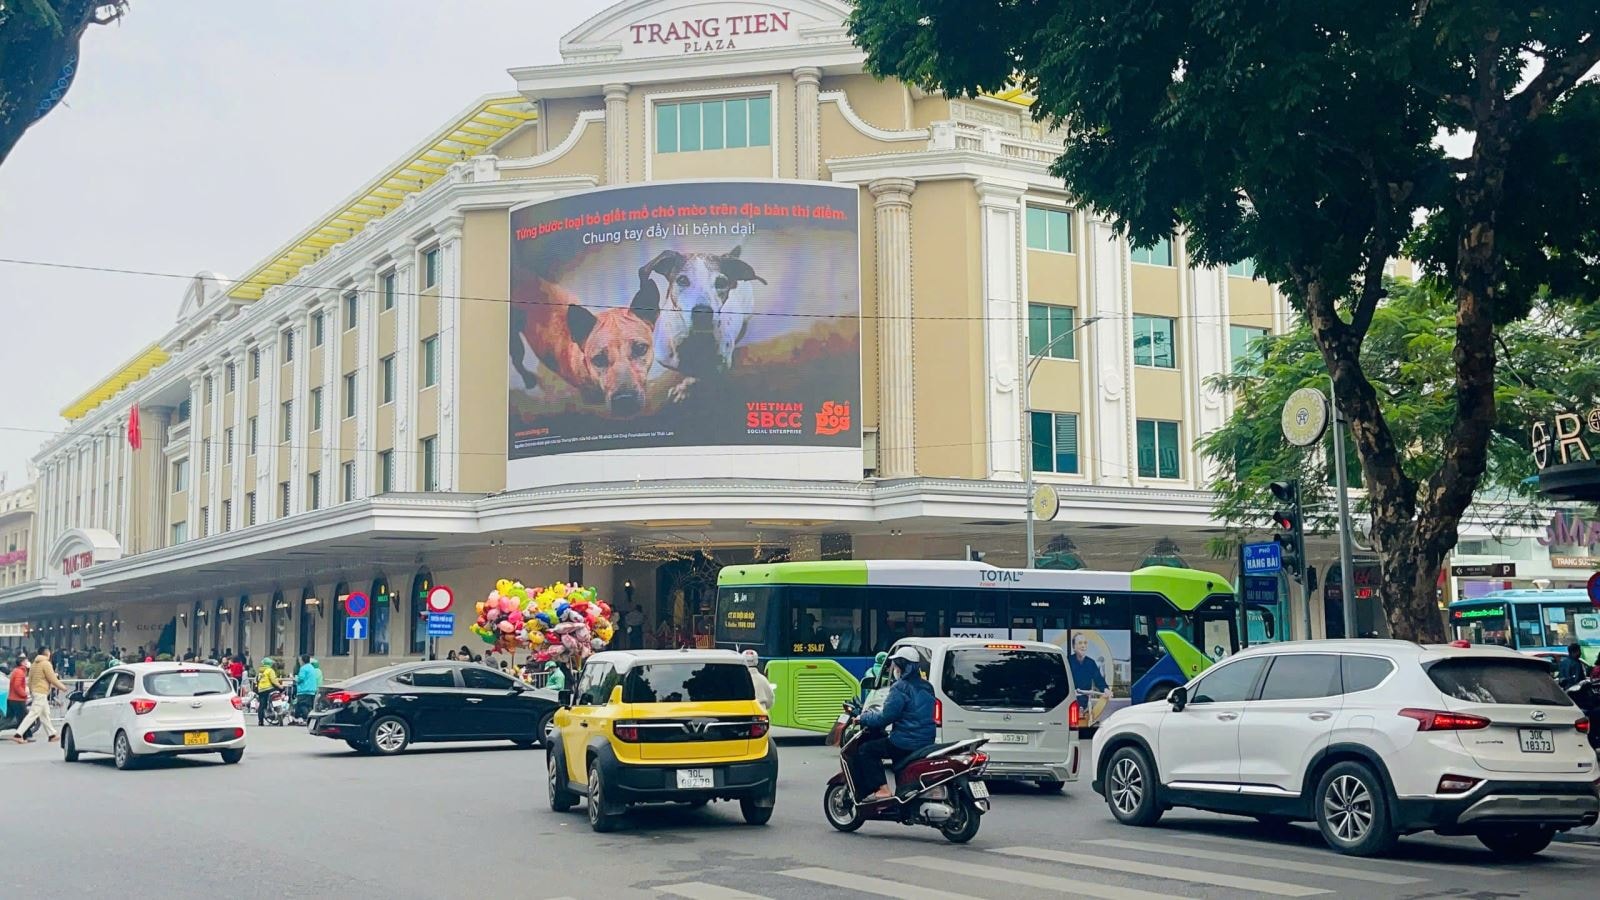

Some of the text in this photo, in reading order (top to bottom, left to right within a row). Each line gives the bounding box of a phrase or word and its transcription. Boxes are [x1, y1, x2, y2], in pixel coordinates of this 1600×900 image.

[630, 12, 790, 44] TRANG TIEN
[684, 39, 736, 52] PLAZA
[652, 205, 675, 218] chó
[677, 204, 707, 216] mèo
[709, 203, 737, 216] trên
[740, 202, 761, 218] địa
[764, 203, 789, 217] bàn
[583, 229, 621, 244] Chung
[624, 228, 643, 241] tay
[673, 224, 688, 236] lùi
[693, 222, 727, 237] bệnh
[731, 222, 755, 237] dại!
[747, 402, 803, 411] VIETNAM
[823, 401, 850, 416] Soi
[747, 412, 802, 428] SBCC
[816, 413, 850, 431] Dog
[1247, 556, 1266, 569] HÀNG
[1556, 557, 1578, 566] TRANG
[980, 570, 1019, 582] TOTAL
[1503, 565, 1510, 575] P
[1083, 595, 1091, 605] 34
[1529, 730, 1543, 740] 30K
[1526, 741, 1551, 751] 183.73
[688, 769, 704, 778] 30L
